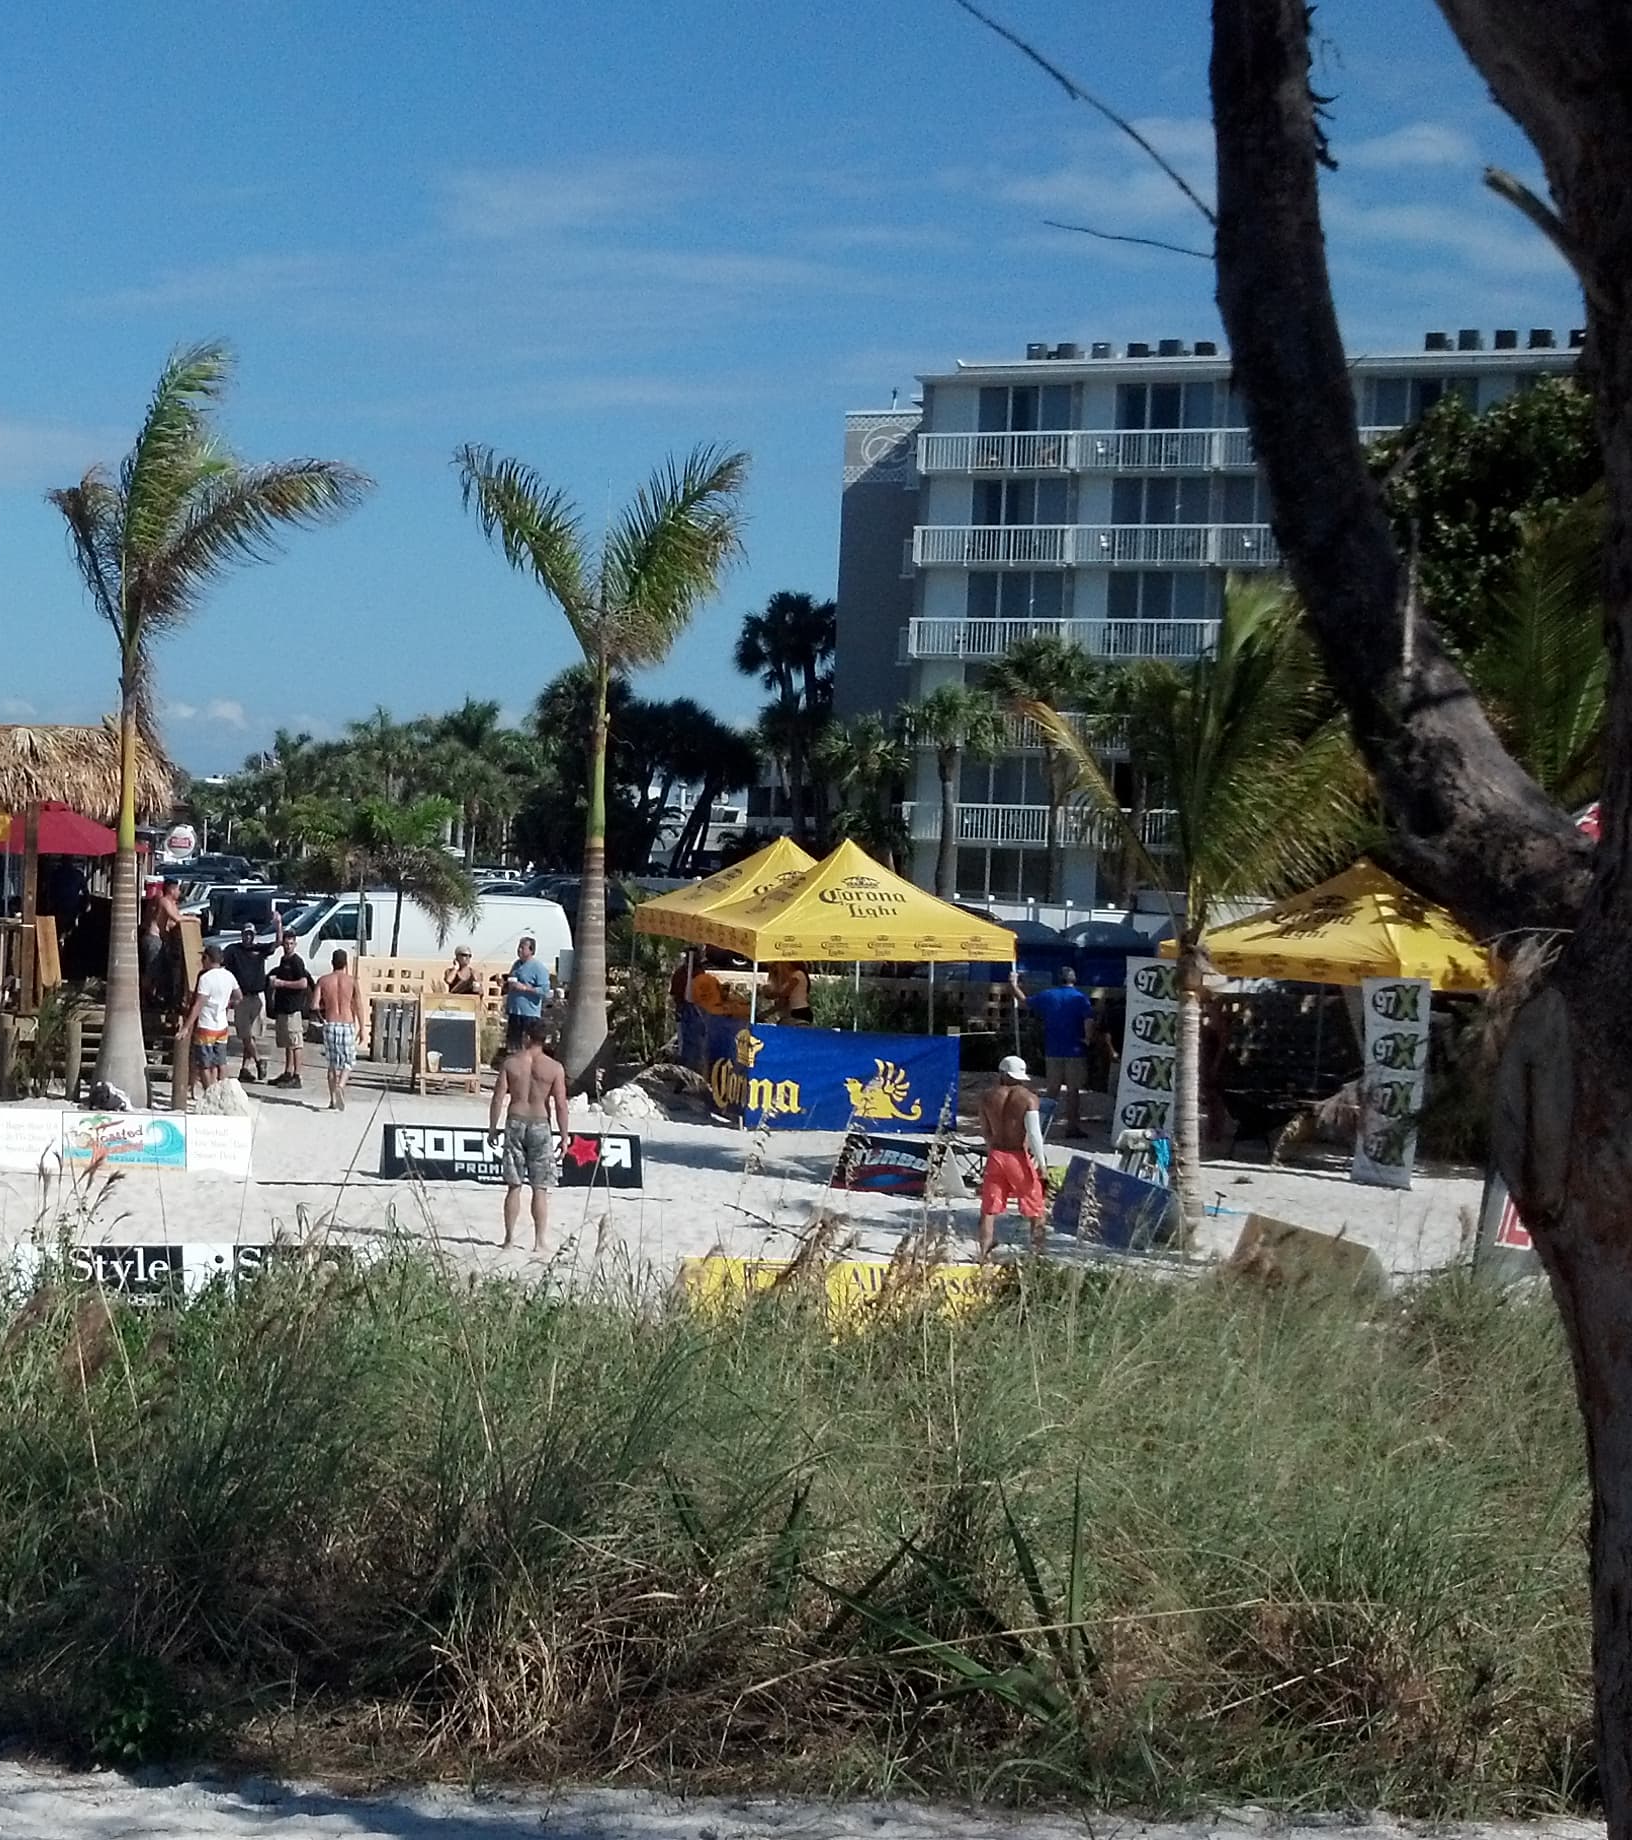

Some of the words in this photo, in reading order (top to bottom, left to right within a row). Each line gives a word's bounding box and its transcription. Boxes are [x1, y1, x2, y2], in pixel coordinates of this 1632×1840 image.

[819, 889, 906, 905] Corona
[845, 904, 898, 919] Light
[1137, 966, 1178, 1000] 97X
[1375, 985, 1420, 1021] 97X
[1135, 1011, 1176, 1045] 97X
[1375, 1033, 1419, 1069] 97X
[1131, 1056, 1174, 1091] 97X
[1125, 1101, 1170, 1129] 97X
[70, 1246, 169, 1291] Style
